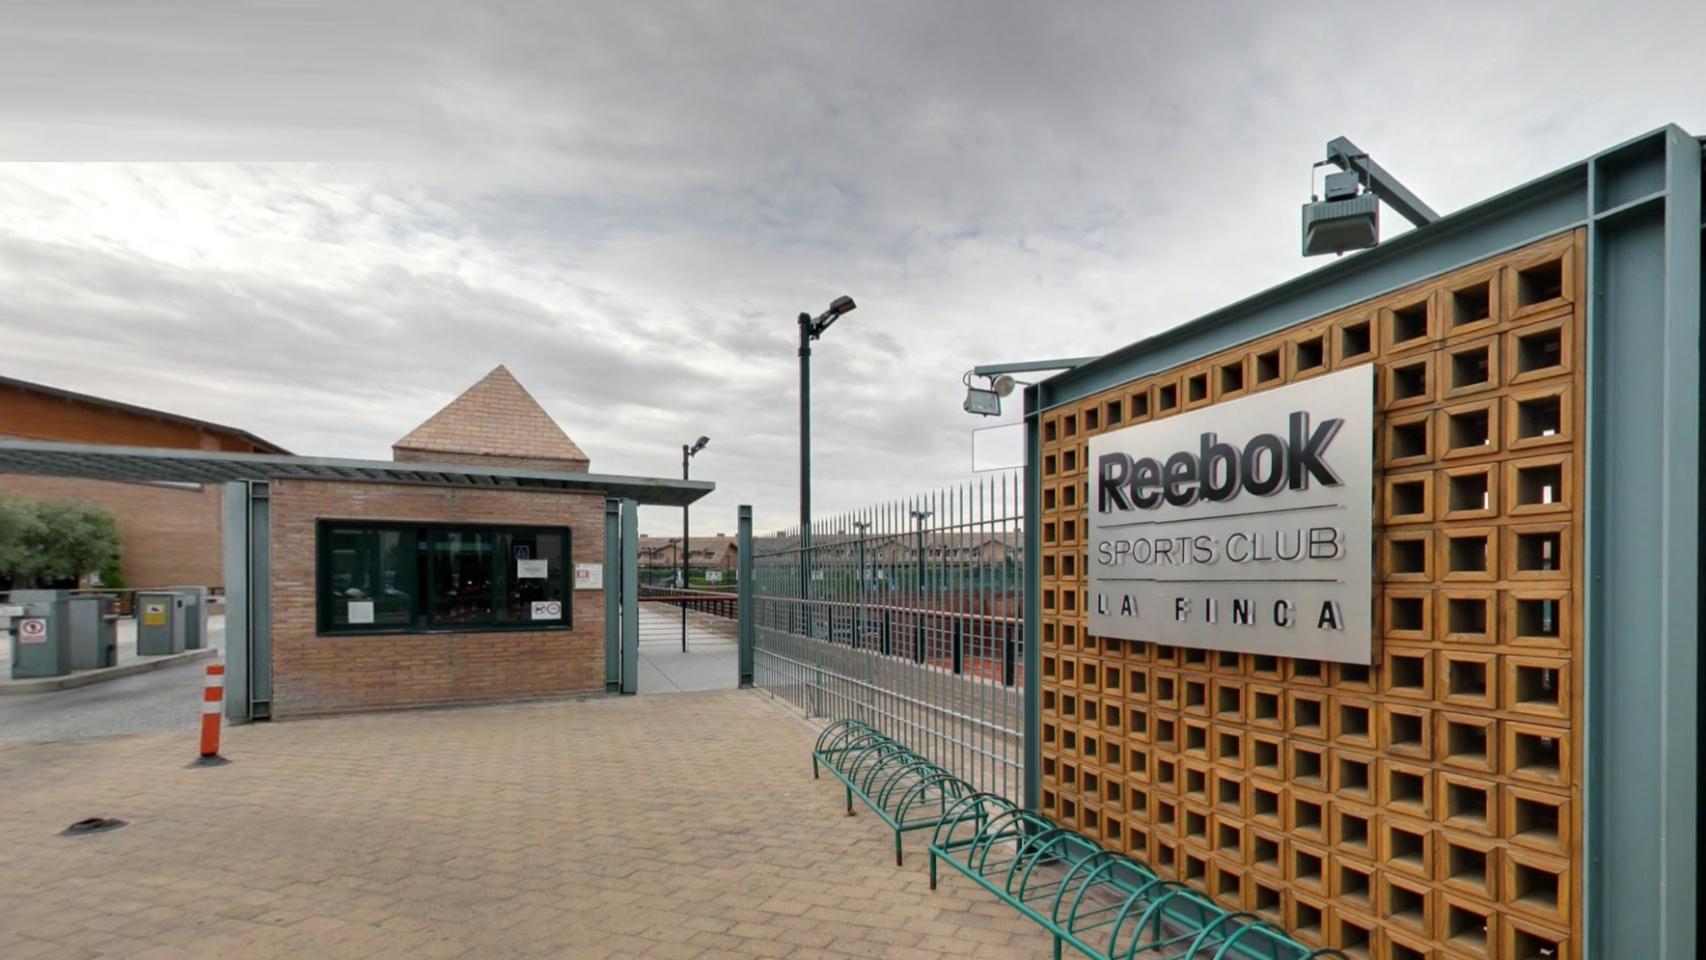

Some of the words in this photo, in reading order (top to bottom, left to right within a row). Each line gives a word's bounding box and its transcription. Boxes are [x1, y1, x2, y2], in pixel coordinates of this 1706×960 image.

[1098, 411, 1344, 513] Reebok
[1097, 535, 1216, 566] SPORTS
[1225, 526, 1341, 563] CLUB
[1098, 594, 1134, 617] LA
[1175, 597, 1340, 630] FINCA
